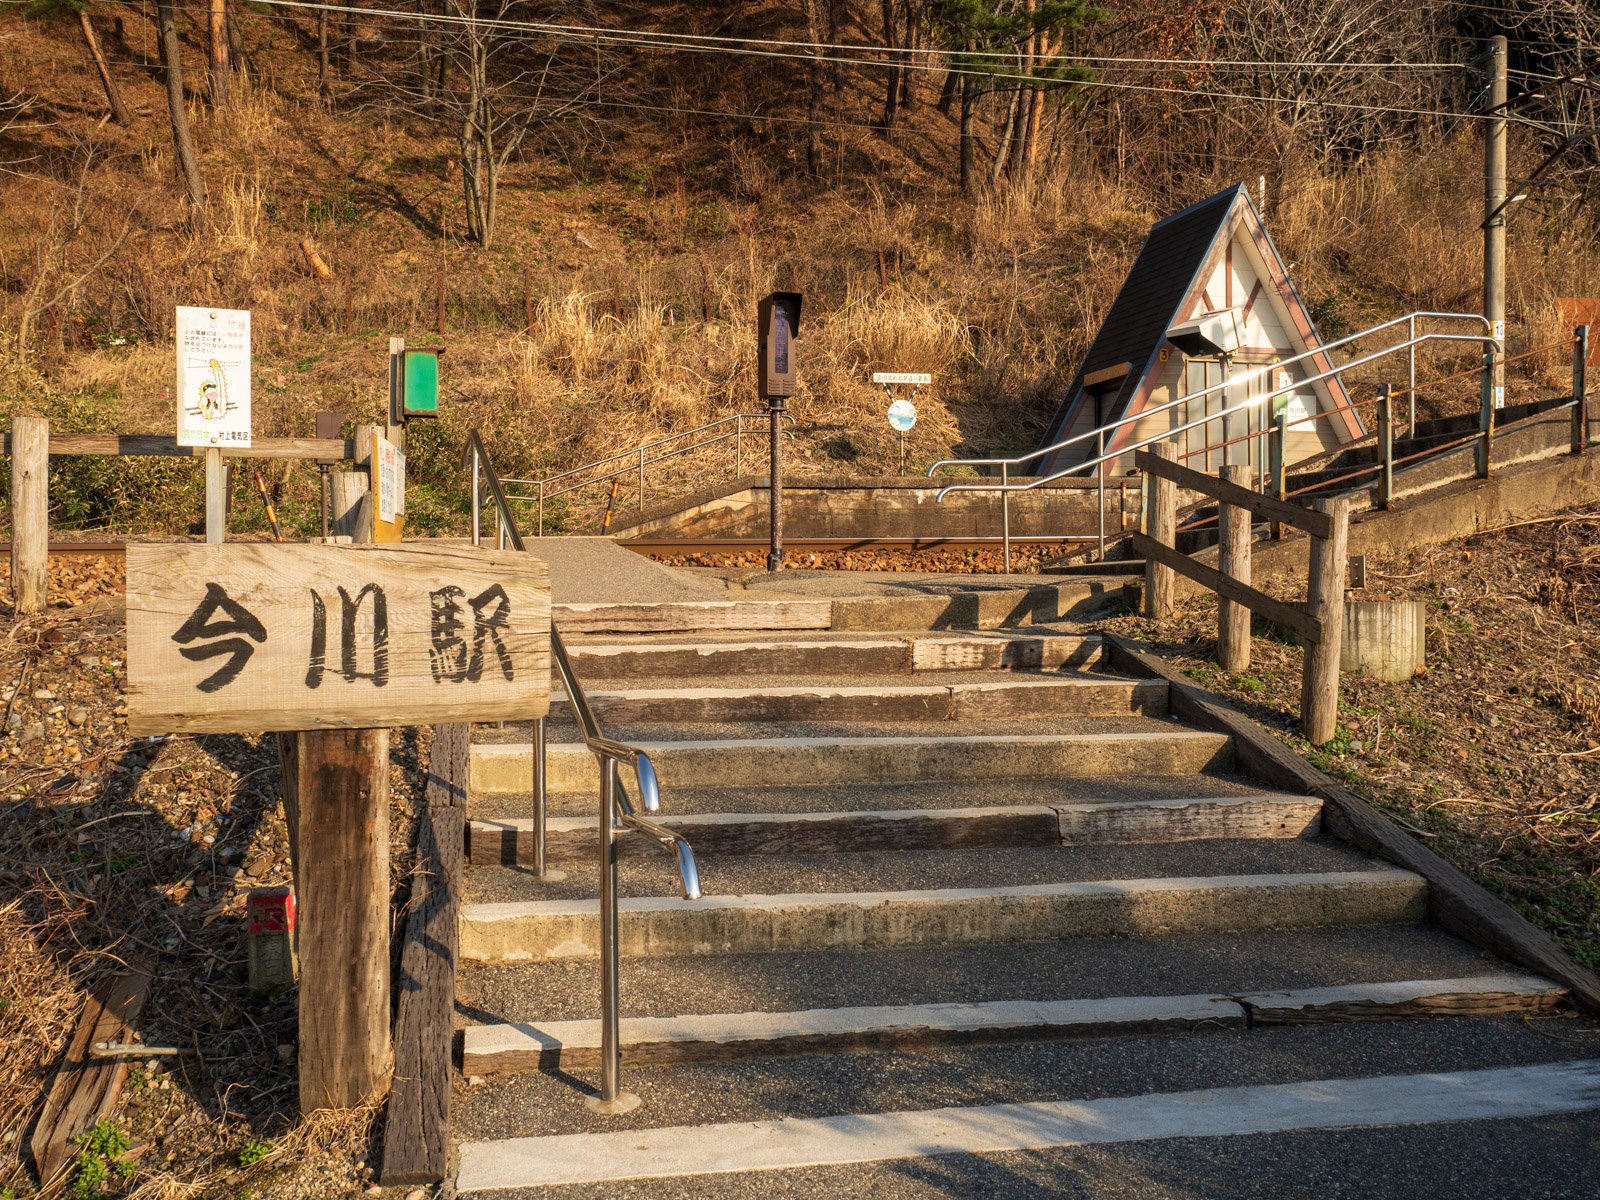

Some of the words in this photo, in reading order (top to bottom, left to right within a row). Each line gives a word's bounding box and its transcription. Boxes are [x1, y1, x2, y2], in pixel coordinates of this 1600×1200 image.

[1160, 350, 1168, 361] 3
[171, 582, 514, 693] 今川駅
